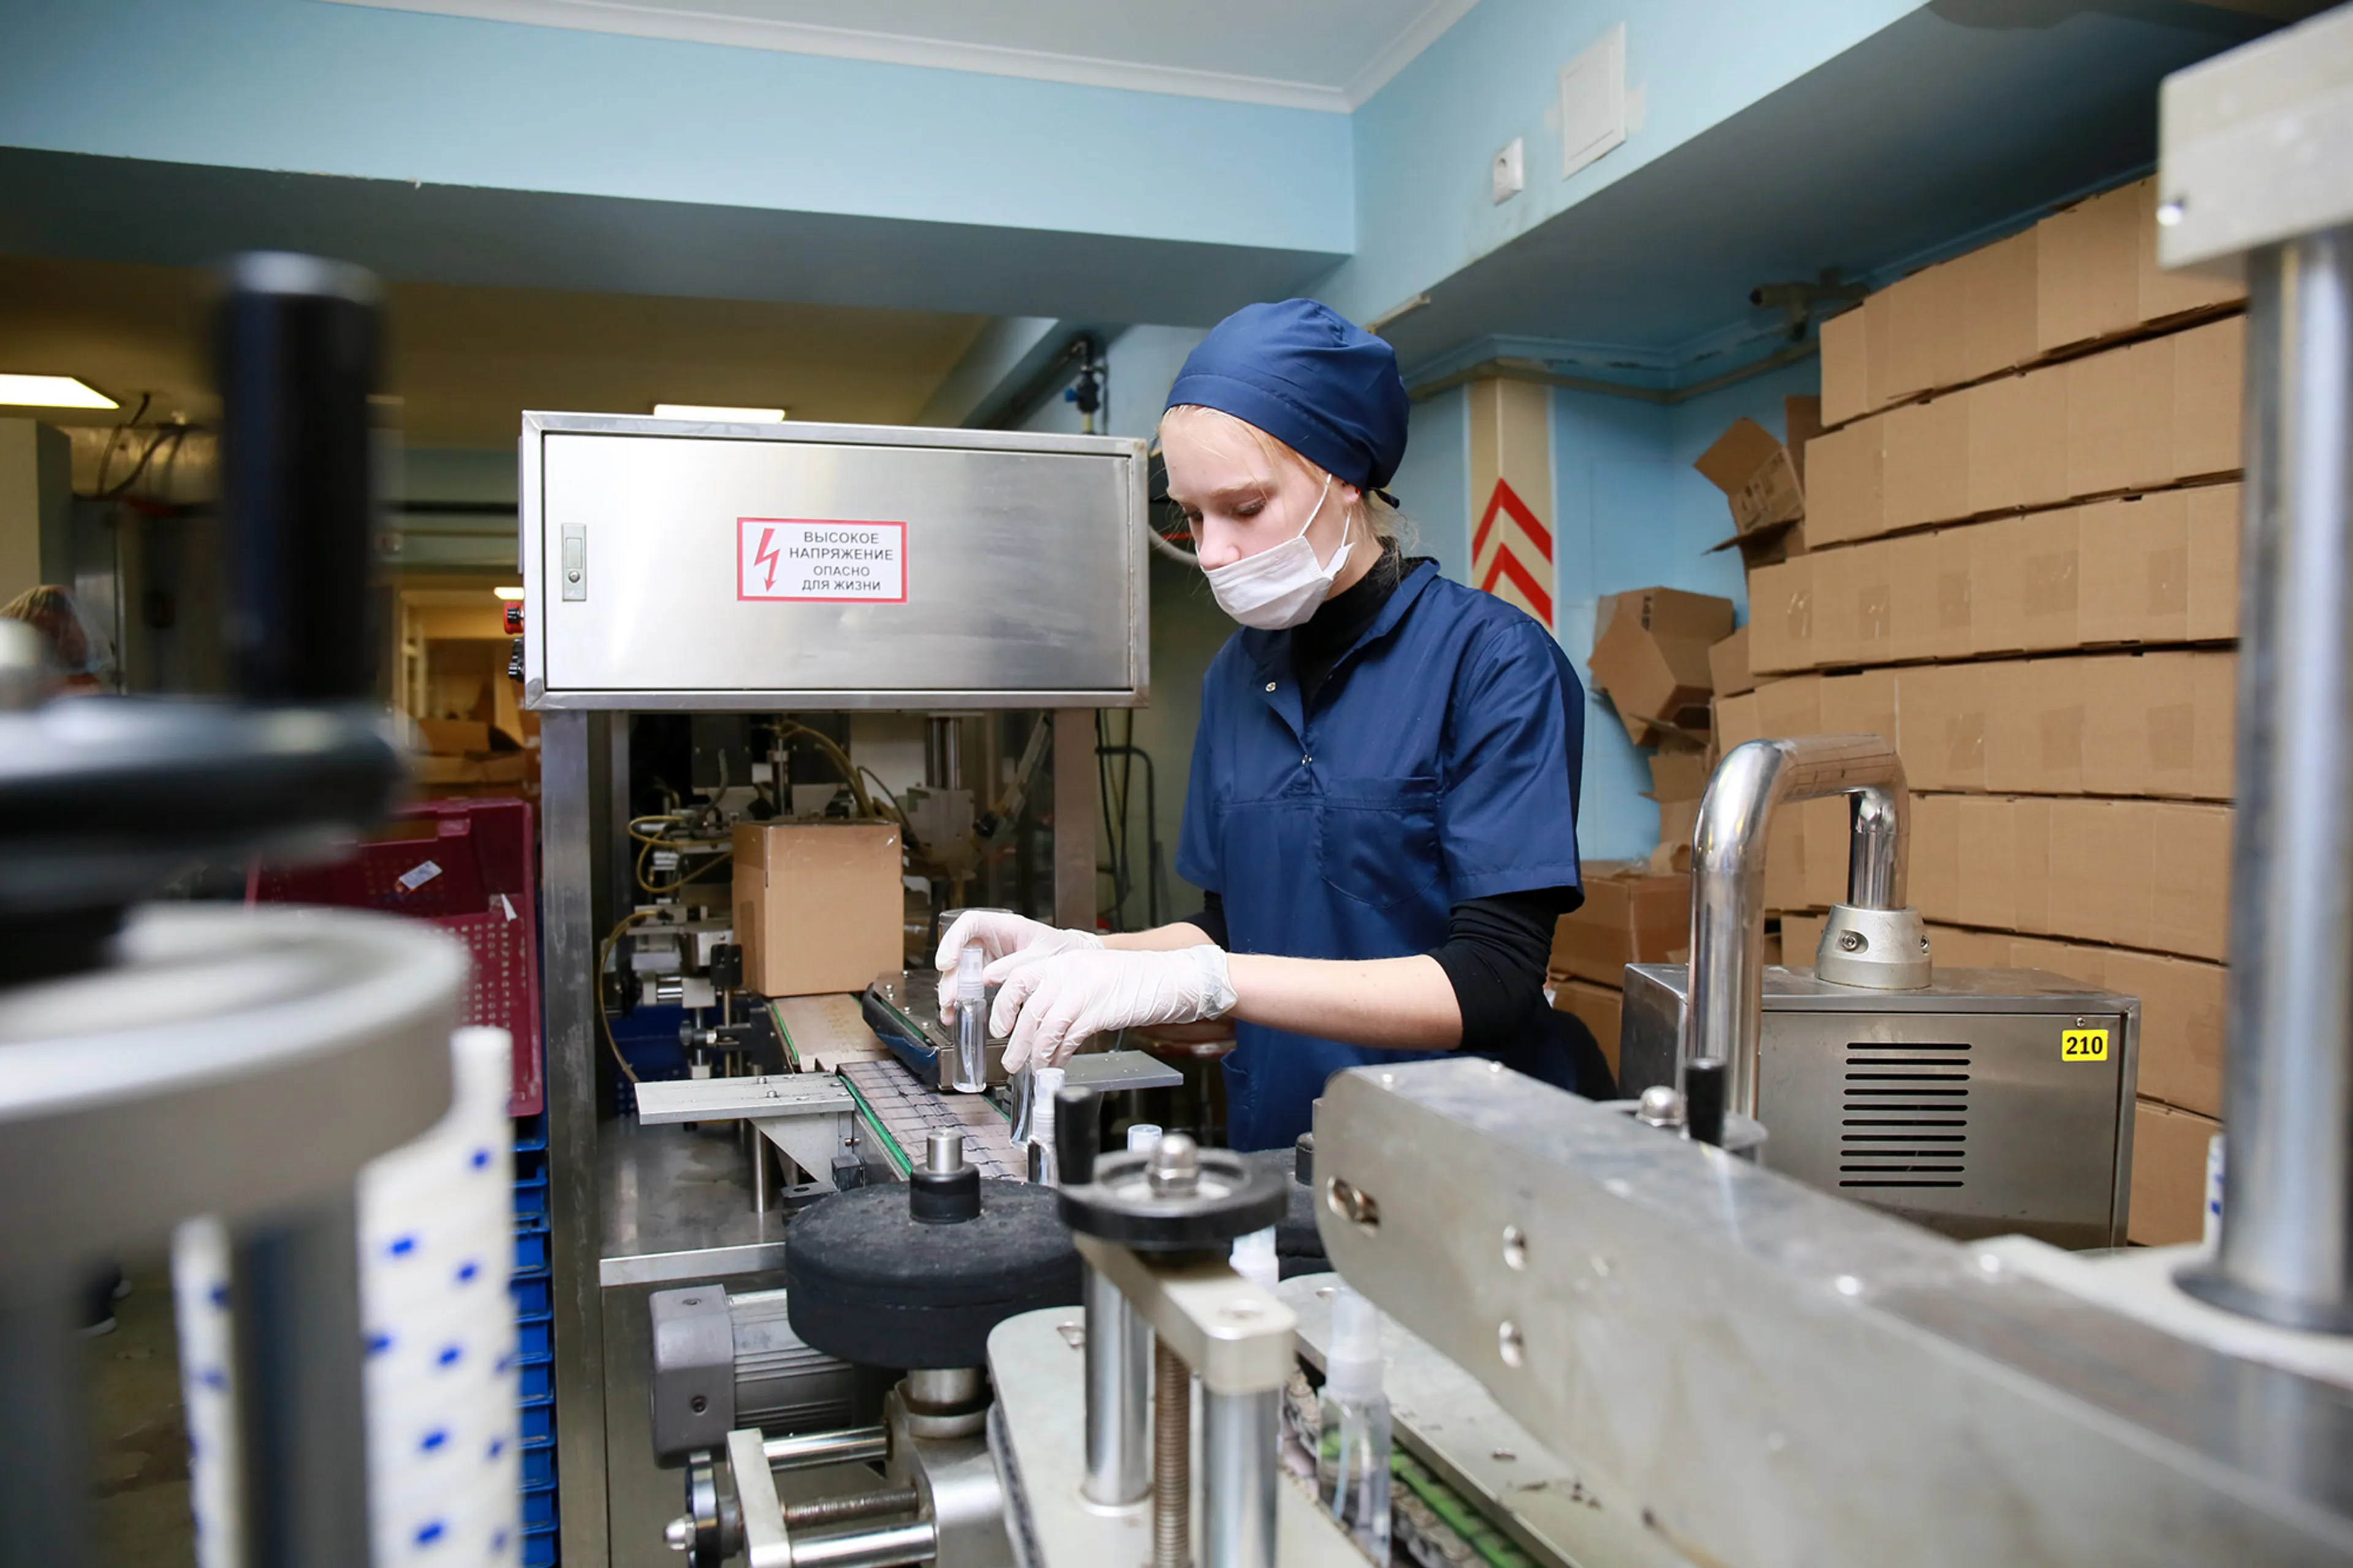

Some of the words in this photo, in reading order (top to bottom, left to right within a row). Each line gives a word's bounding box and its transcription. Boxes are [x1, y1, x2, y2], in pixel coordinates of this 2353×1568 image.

[805, 531, 879, 544] ВЫСОКОЕ
[790, 548, 893, 561] НАПРЯЖЕНИЕ
[813, 566, 870, 577] ОПАСНО
[802, 580, 830, 592] ДЛЯ
[835, 581, 881, 591] ЖИЗНИ
[2066, 1036, 2102, 1055] 210
